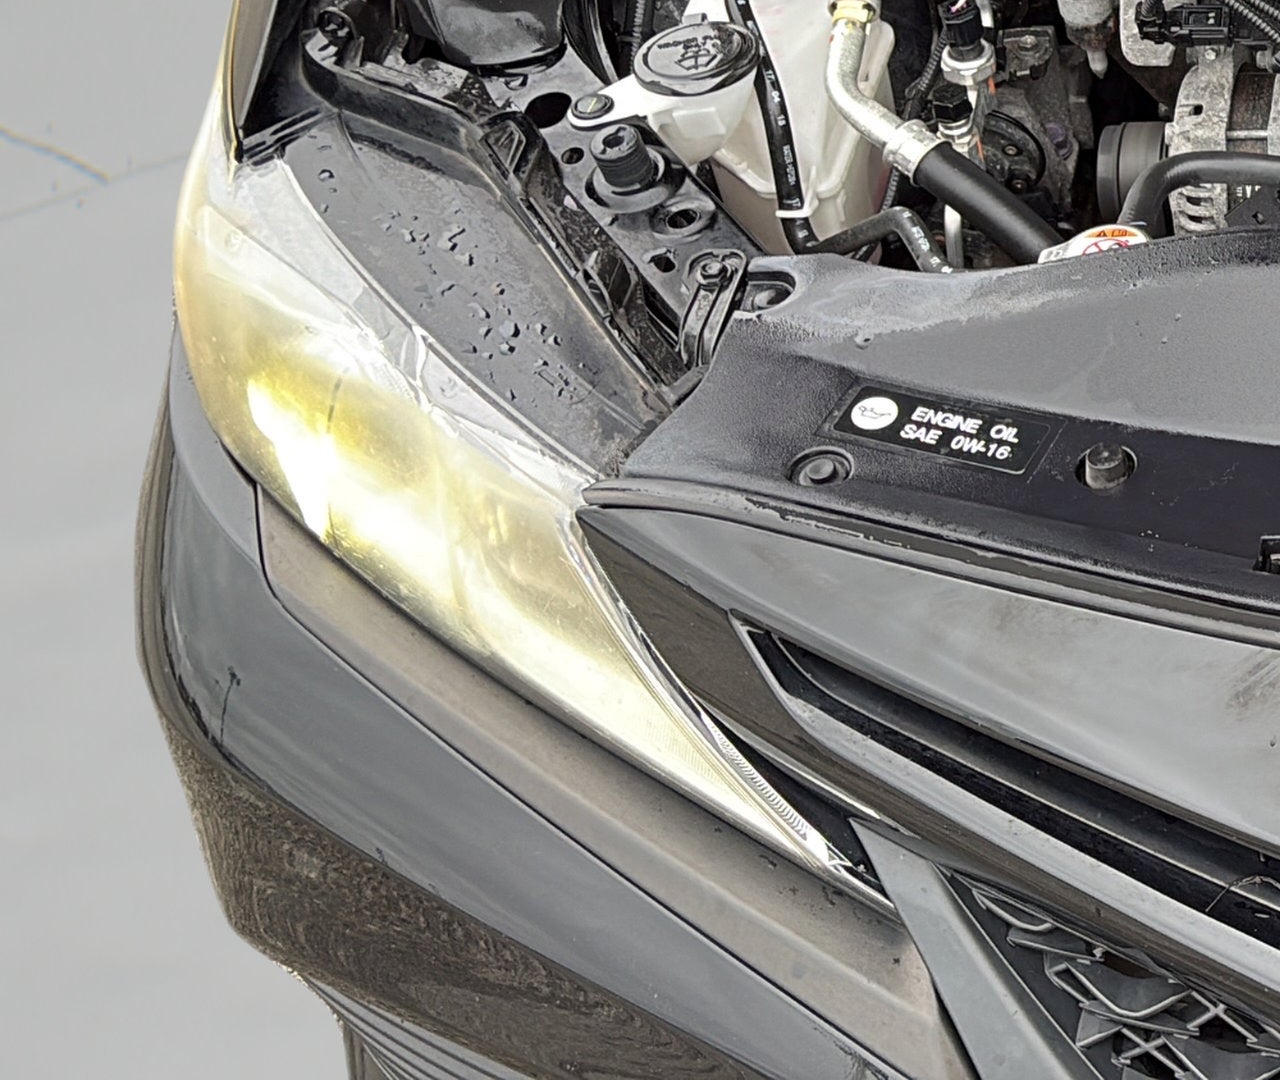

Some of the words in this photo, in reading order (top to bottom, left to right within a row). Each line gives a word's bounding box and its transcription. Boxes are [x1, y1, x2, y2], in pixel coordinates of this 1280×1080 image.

[899, 423, 943, 445] SAE
[950, 435, 1012, 460] 0W-16
[910, 406, 983, 434] ENGINE
[989, 424, 1019, 443] OIL
